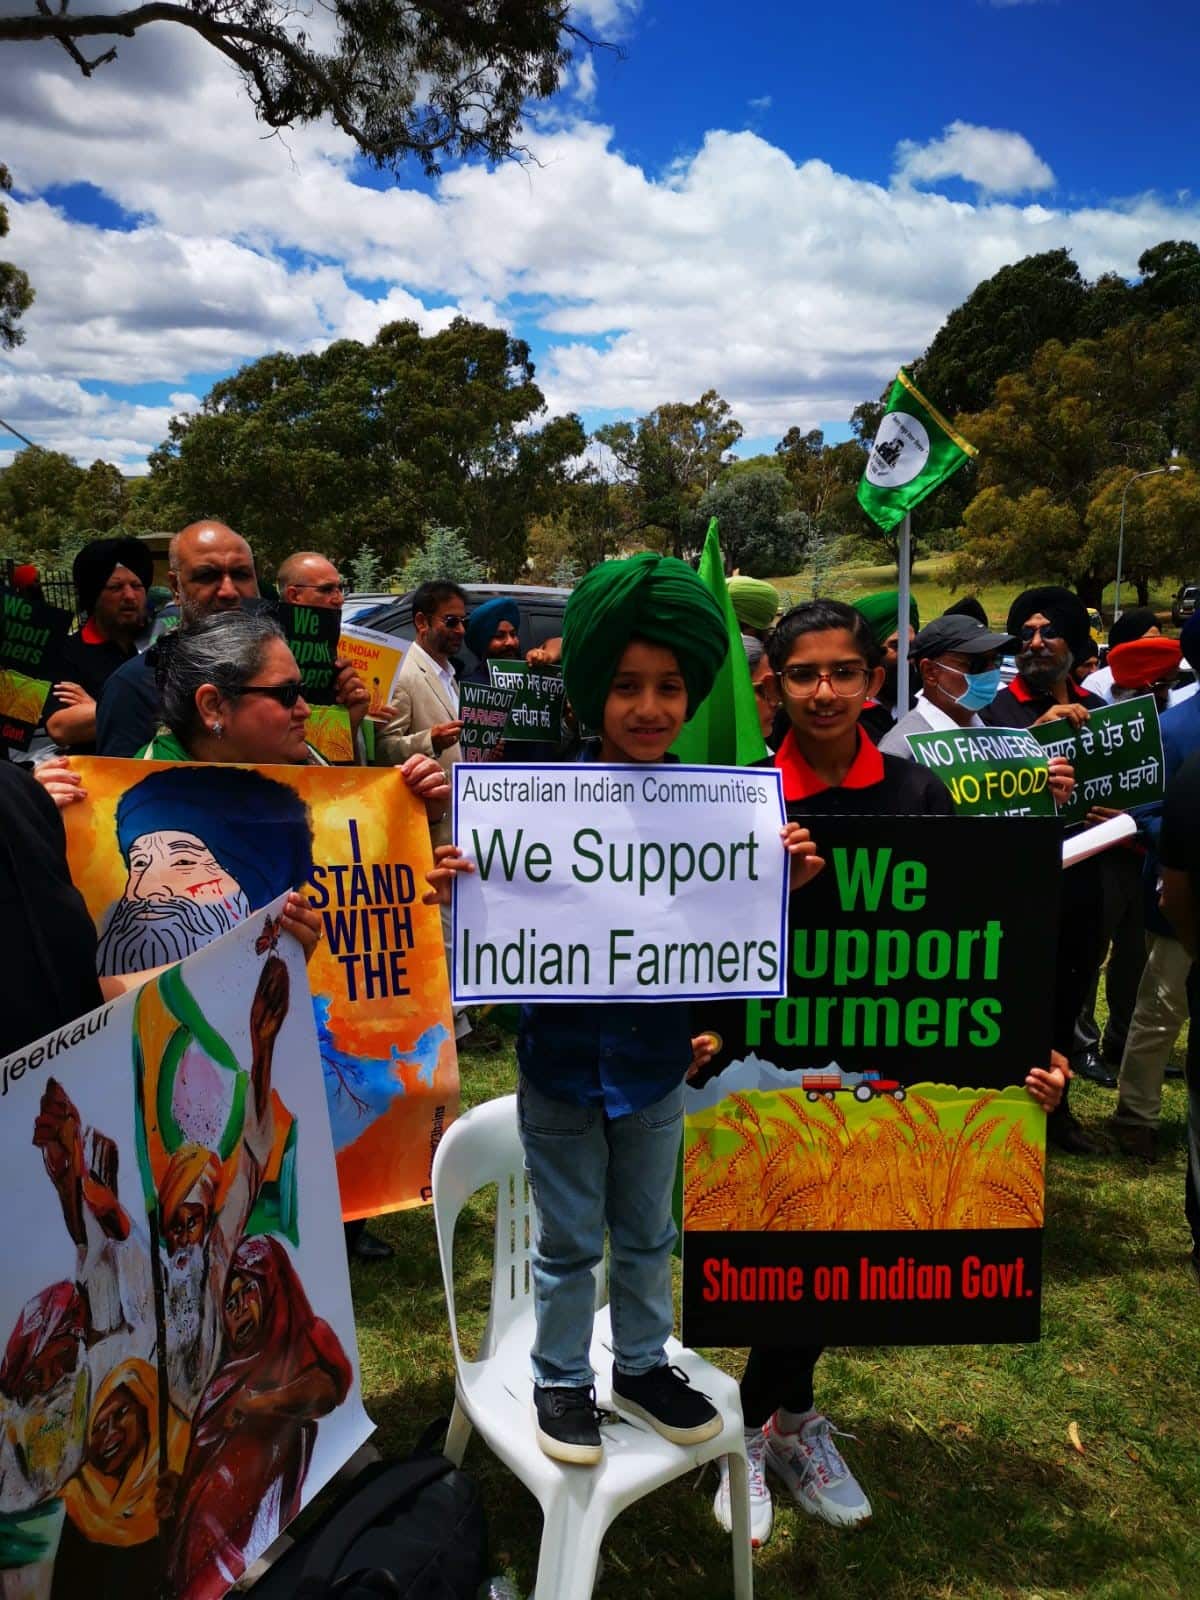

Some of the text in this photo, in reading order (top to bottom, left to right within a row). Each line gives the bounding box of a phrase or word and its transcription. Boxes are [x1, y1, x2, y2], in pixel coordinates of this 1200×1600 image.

[5, 593, 33, 621] We
[293, 606, 320, 636] We
[464, 686, 513, 708] WITHOUT
[461, 729, 477, 744] NO
[917, 735, 1043, 768] NO FARMERS
[1081, 727, 1095, 755] ਦੇ
[1128, 712, 1145, 743] ਹਾਂ
[462, 775, 768, 804] Australian Indian Communities
[985, 767, 1049, 801] FOOD
[1084, 774, 1112, 801] ਨਾਲ
[349, 819, 361, 864] I
[471, 828, 759, 896] We Support
[308, 863, 416, 909] STAND
[833, 847, 927, 911] We
[322, 906, 414, 955] WITH
[793, 920, 1004, 986] upport
[338, 950, 410, 1001] THE
[463, 928, 778, 986] Indian Farmers
[746, 997, 1002, 1047] Farmers
[2, 1005, 114, 1096] jeetkaur
[703, 1256, 1034, 1301] Shame on Indian Govt.
